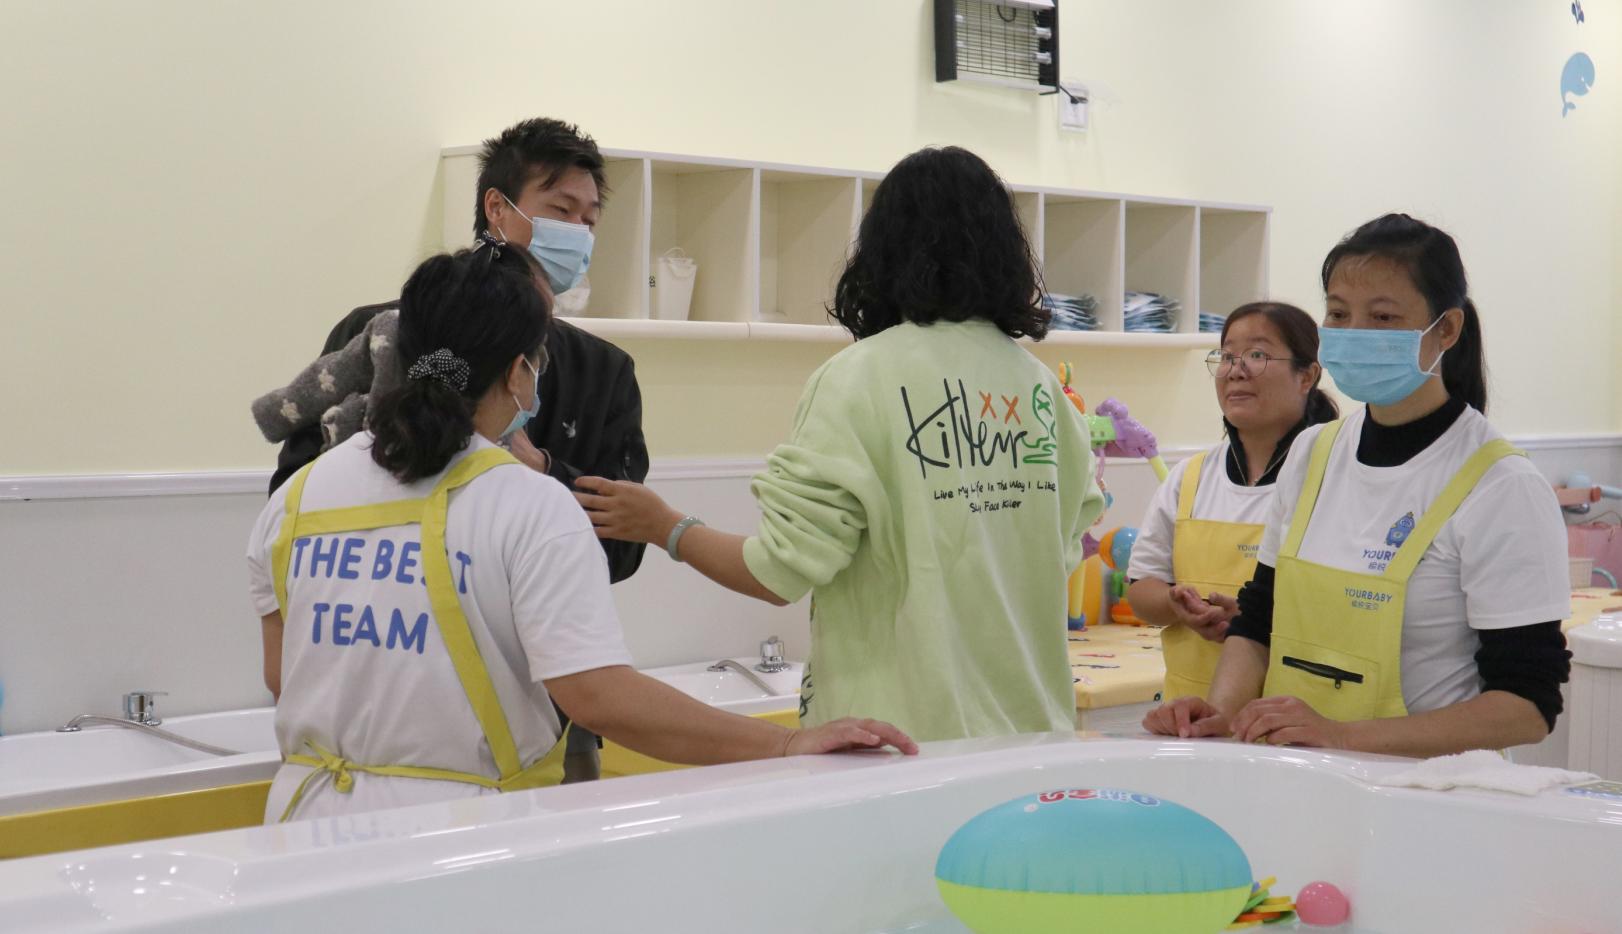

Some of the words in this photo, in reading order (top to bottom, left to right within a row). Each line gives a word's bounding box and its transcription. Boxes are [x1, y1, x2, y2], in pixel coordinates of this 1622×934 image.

[934, 490, 954, 501] Live
[958, 486, 969, 498] My
[970, 481, 984, 497] Life
[987, 482, 995, 492] In
[996, 481, 1008, 491] The
[1009, 480, 1025, 493] Way
[1037, 481, 1057, 492] Like
[984, 501, 1000, 511] Face
[293, 537, 366, 580] THE
[371, 538, 472, 595] BET
[1344, 587, 1393, 603] YOURBABY
[312, 602, 429, 655] TEAM
